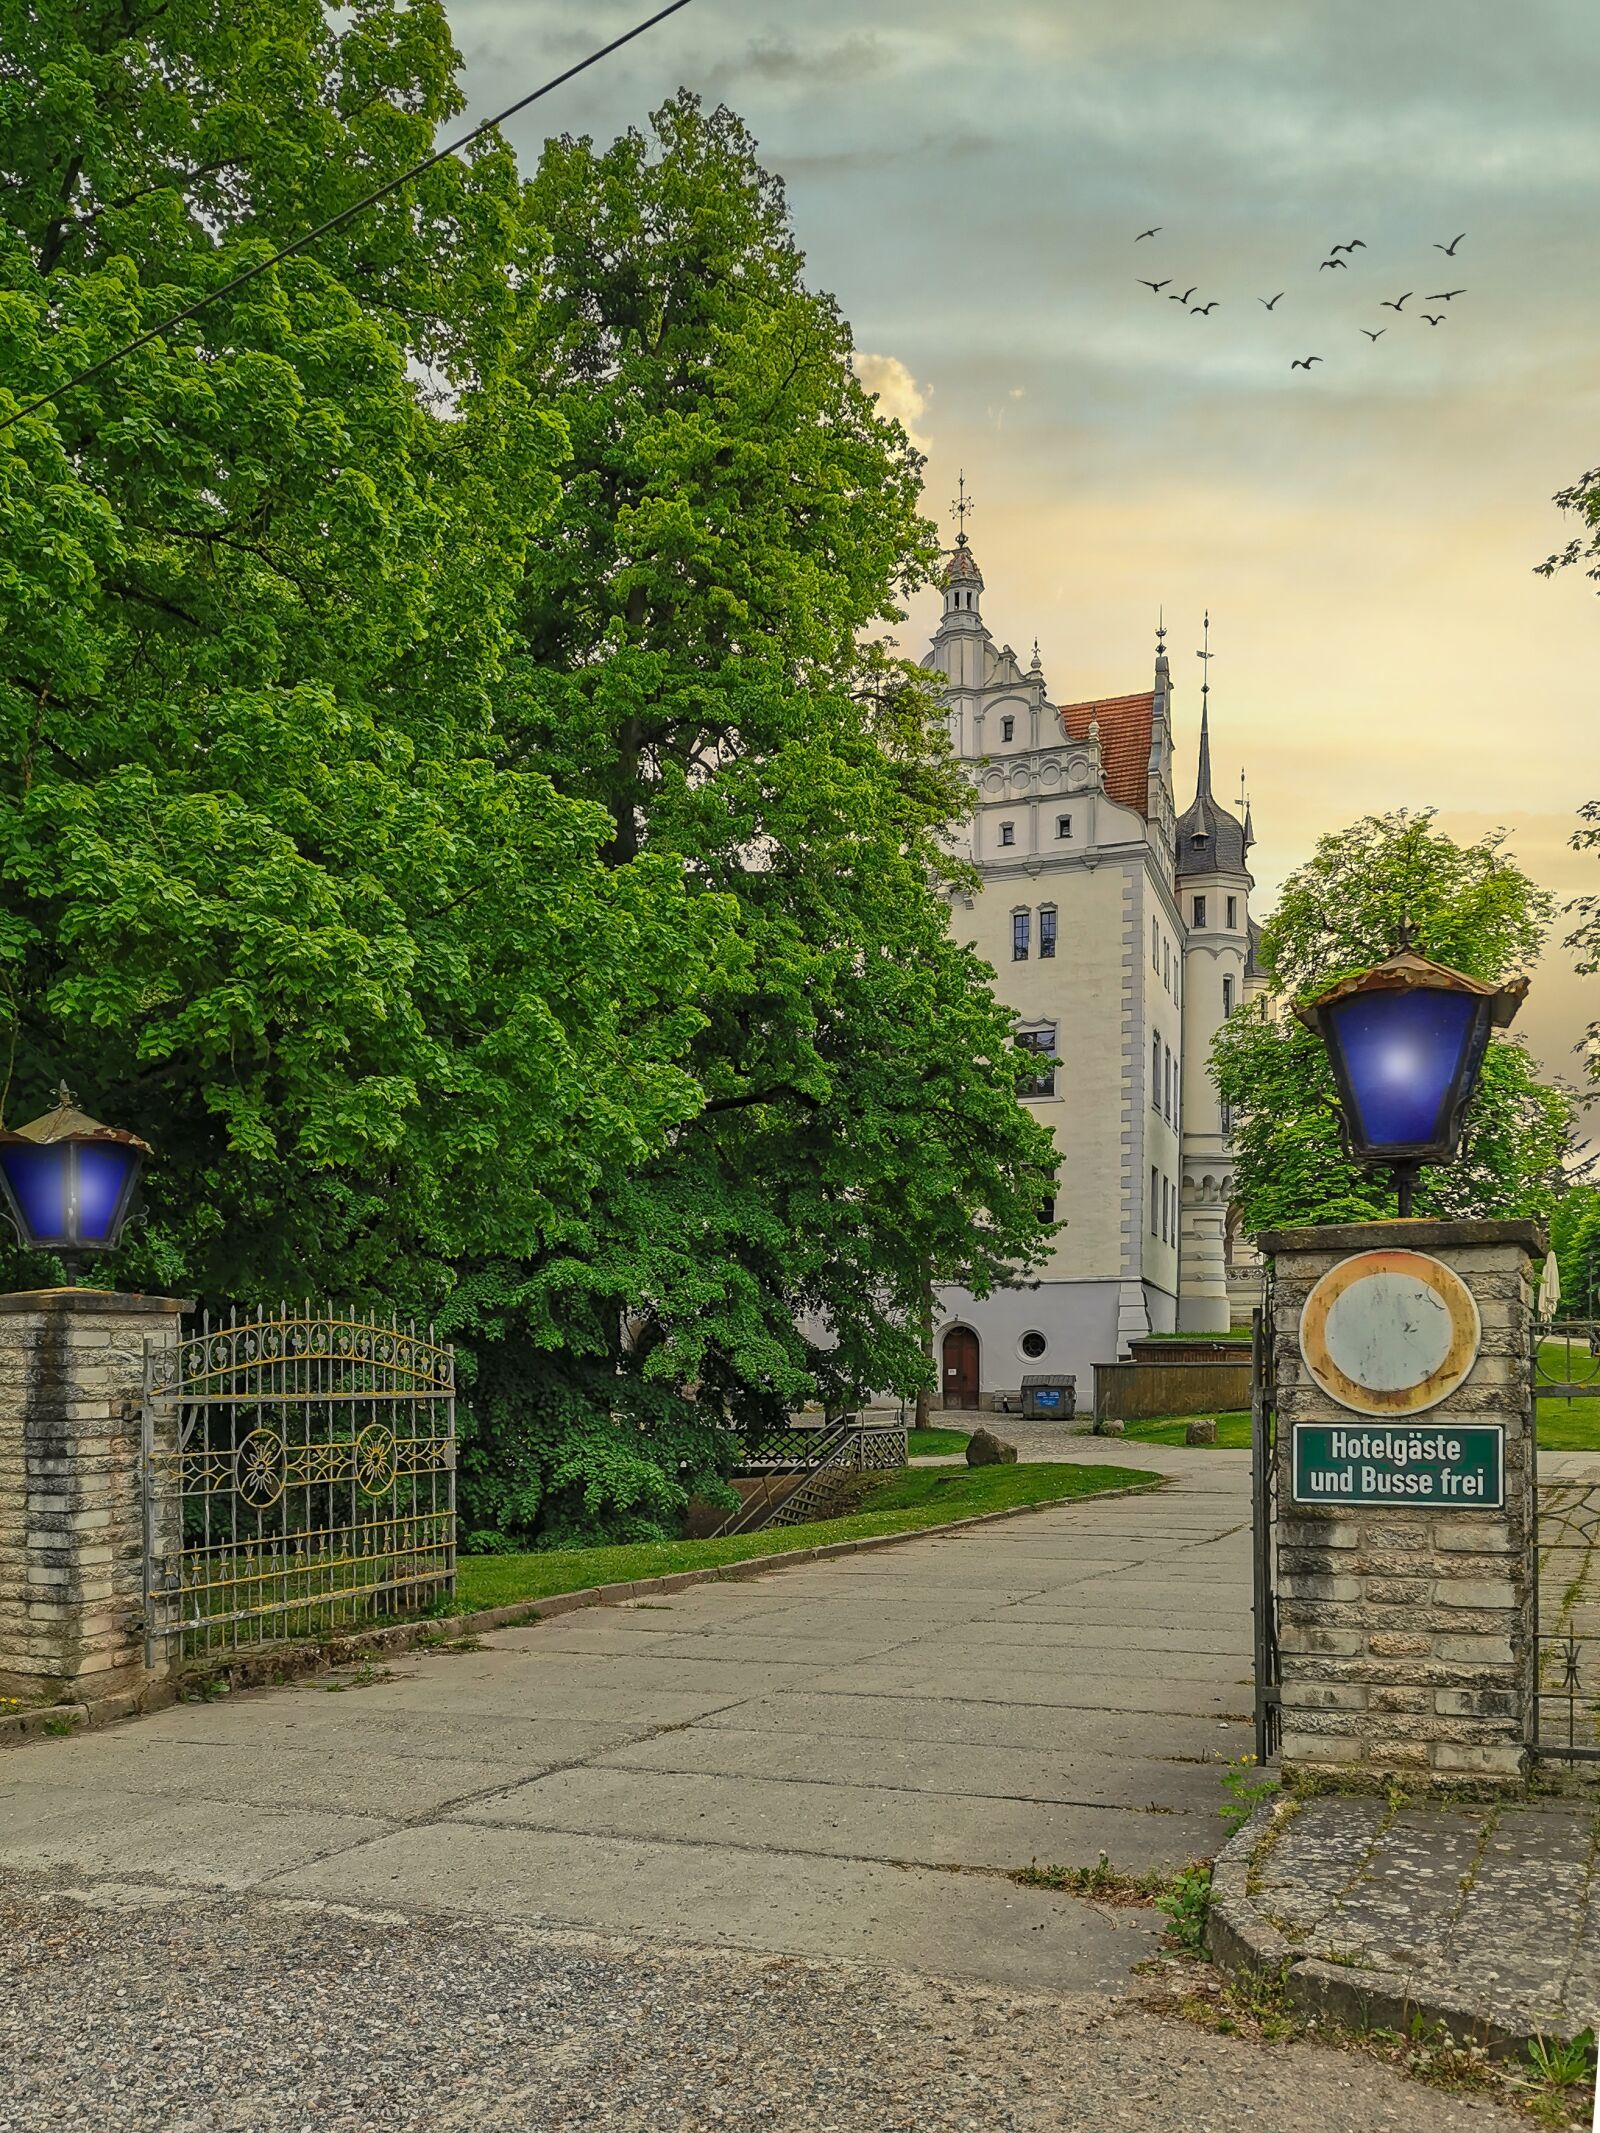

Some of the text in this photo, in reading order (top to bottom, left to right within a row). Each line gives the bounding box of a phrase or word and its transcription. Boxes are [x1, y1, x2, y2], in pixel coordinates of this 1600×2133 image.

[1332, 1431, 1461, 1467] Hotelgäste
[1310, 1465, 1484, 1496] und Busse frei
